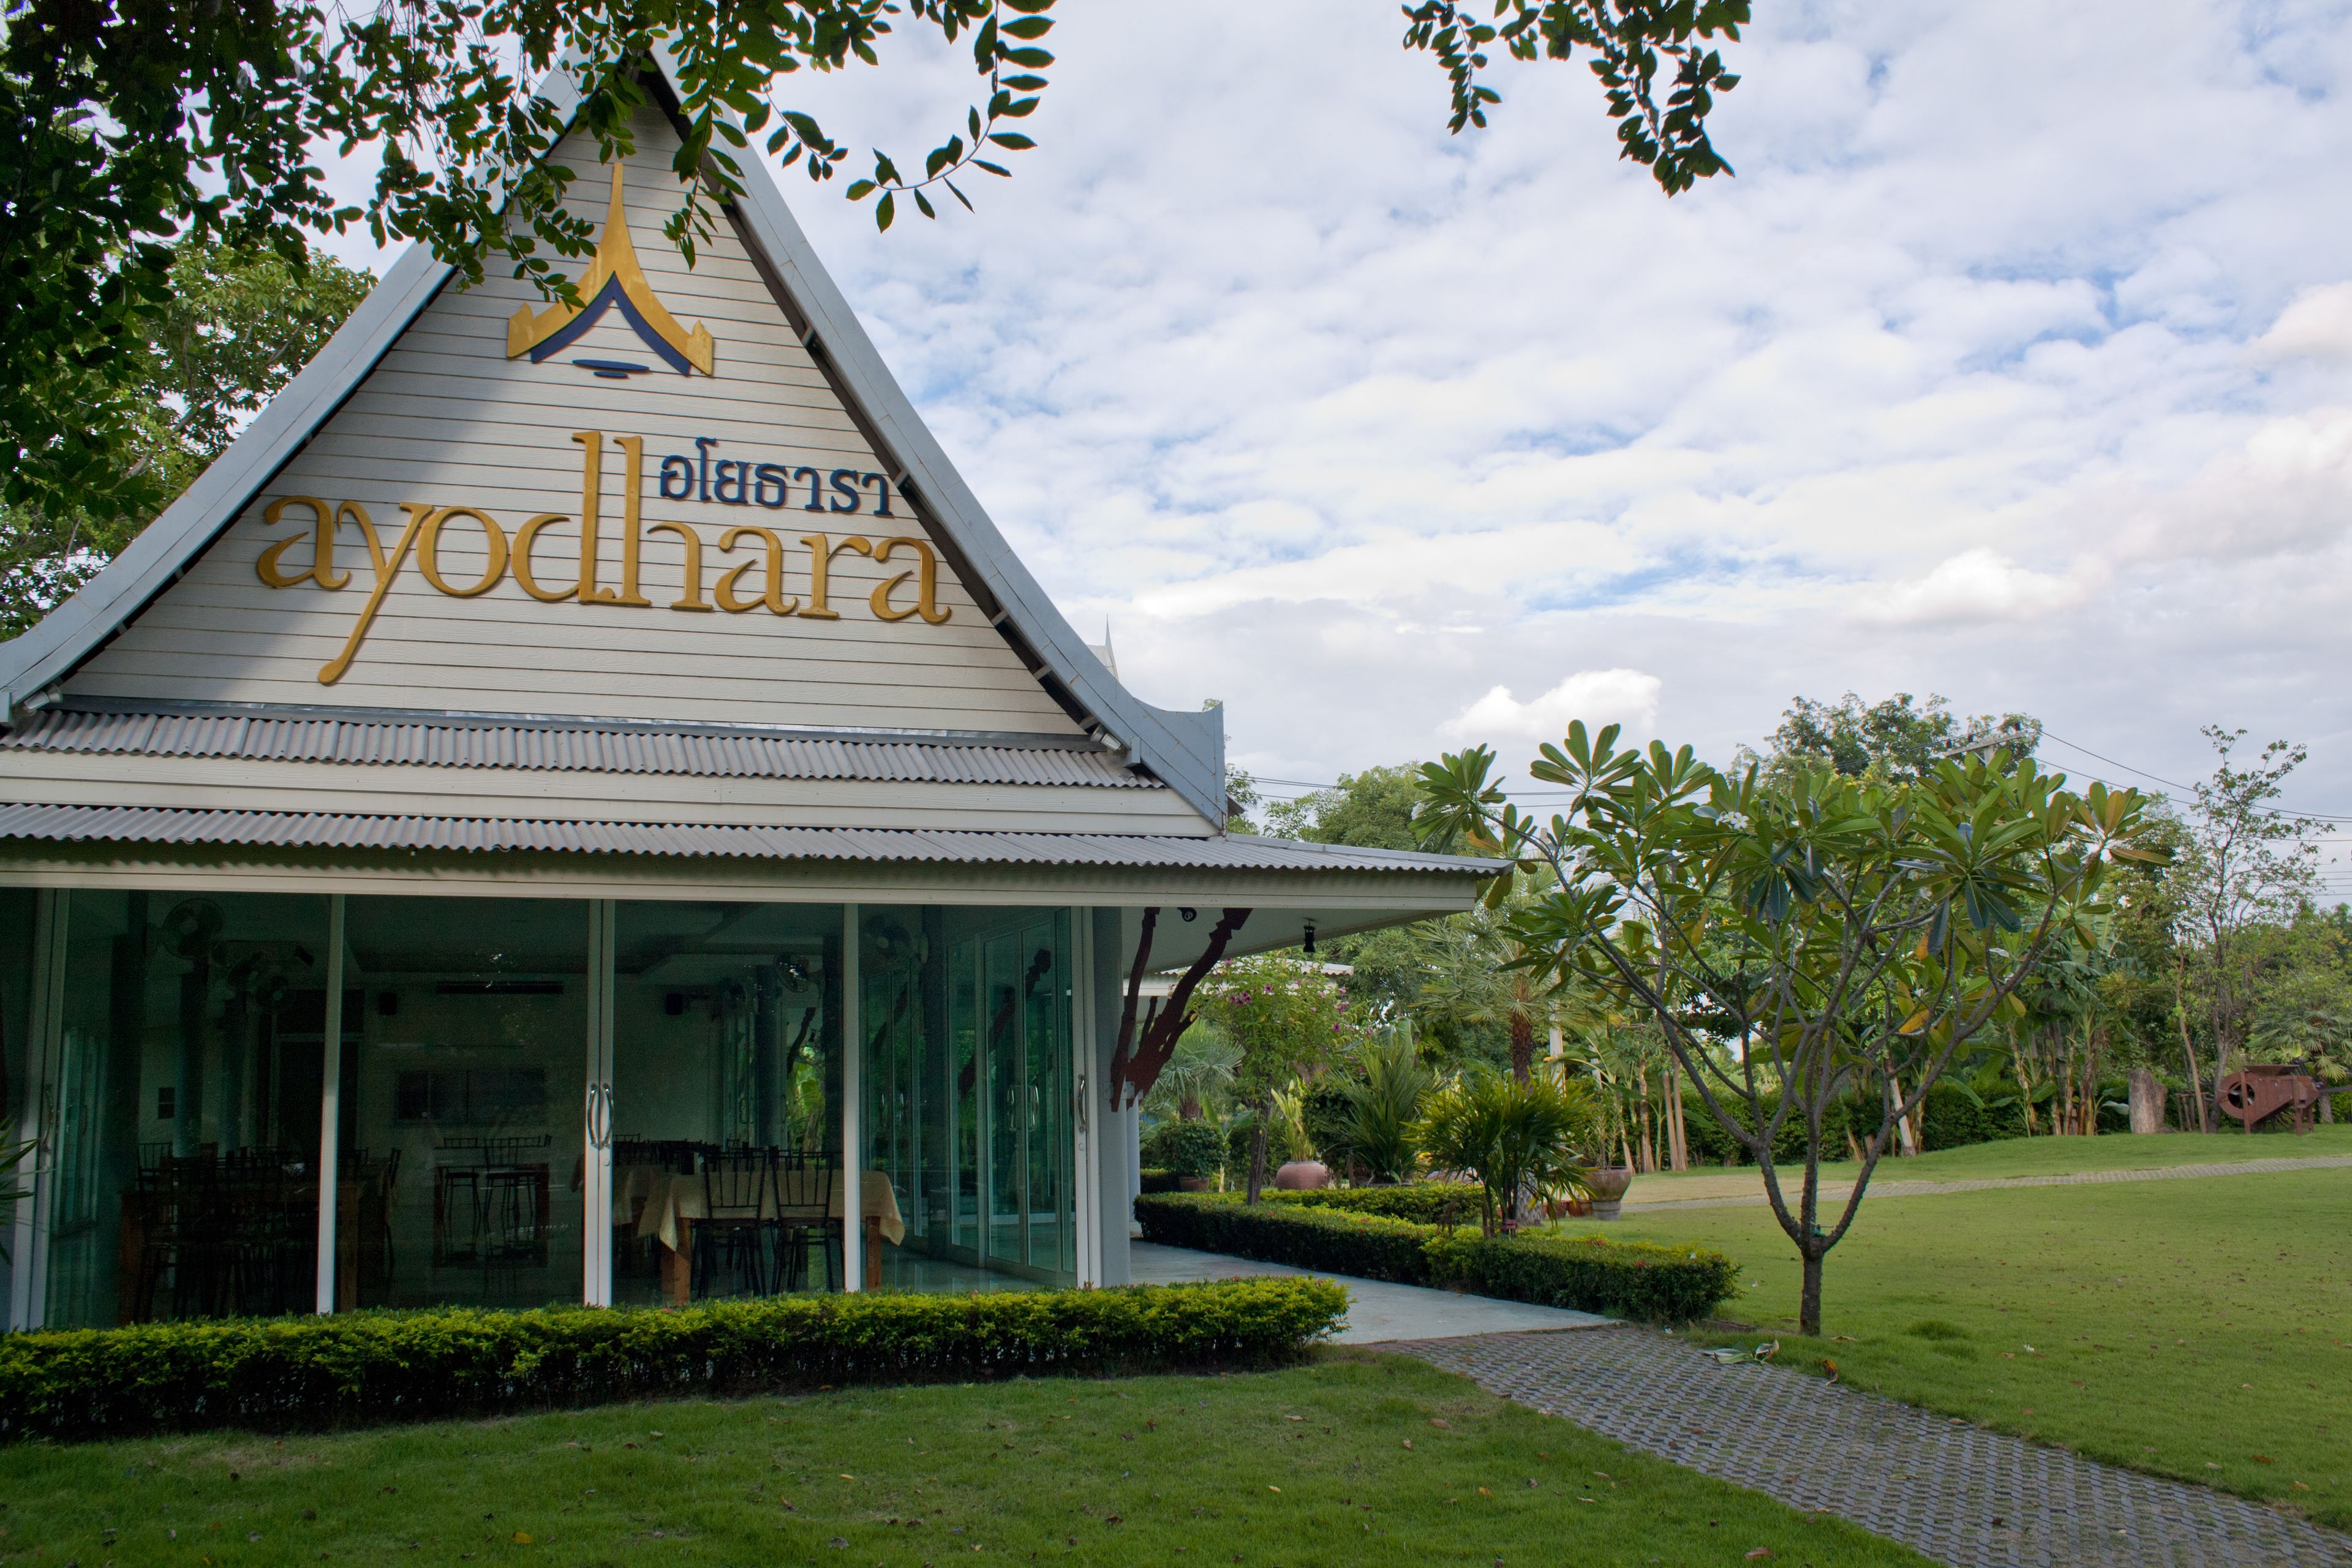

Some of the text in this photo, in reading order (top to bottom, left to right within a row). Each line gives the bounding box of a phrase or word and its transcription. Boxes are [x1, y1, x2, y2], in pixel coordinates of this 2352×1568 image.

[255, 430, 952, 685] ayodhara
[660, 436, 894, 516] อโยธารา
